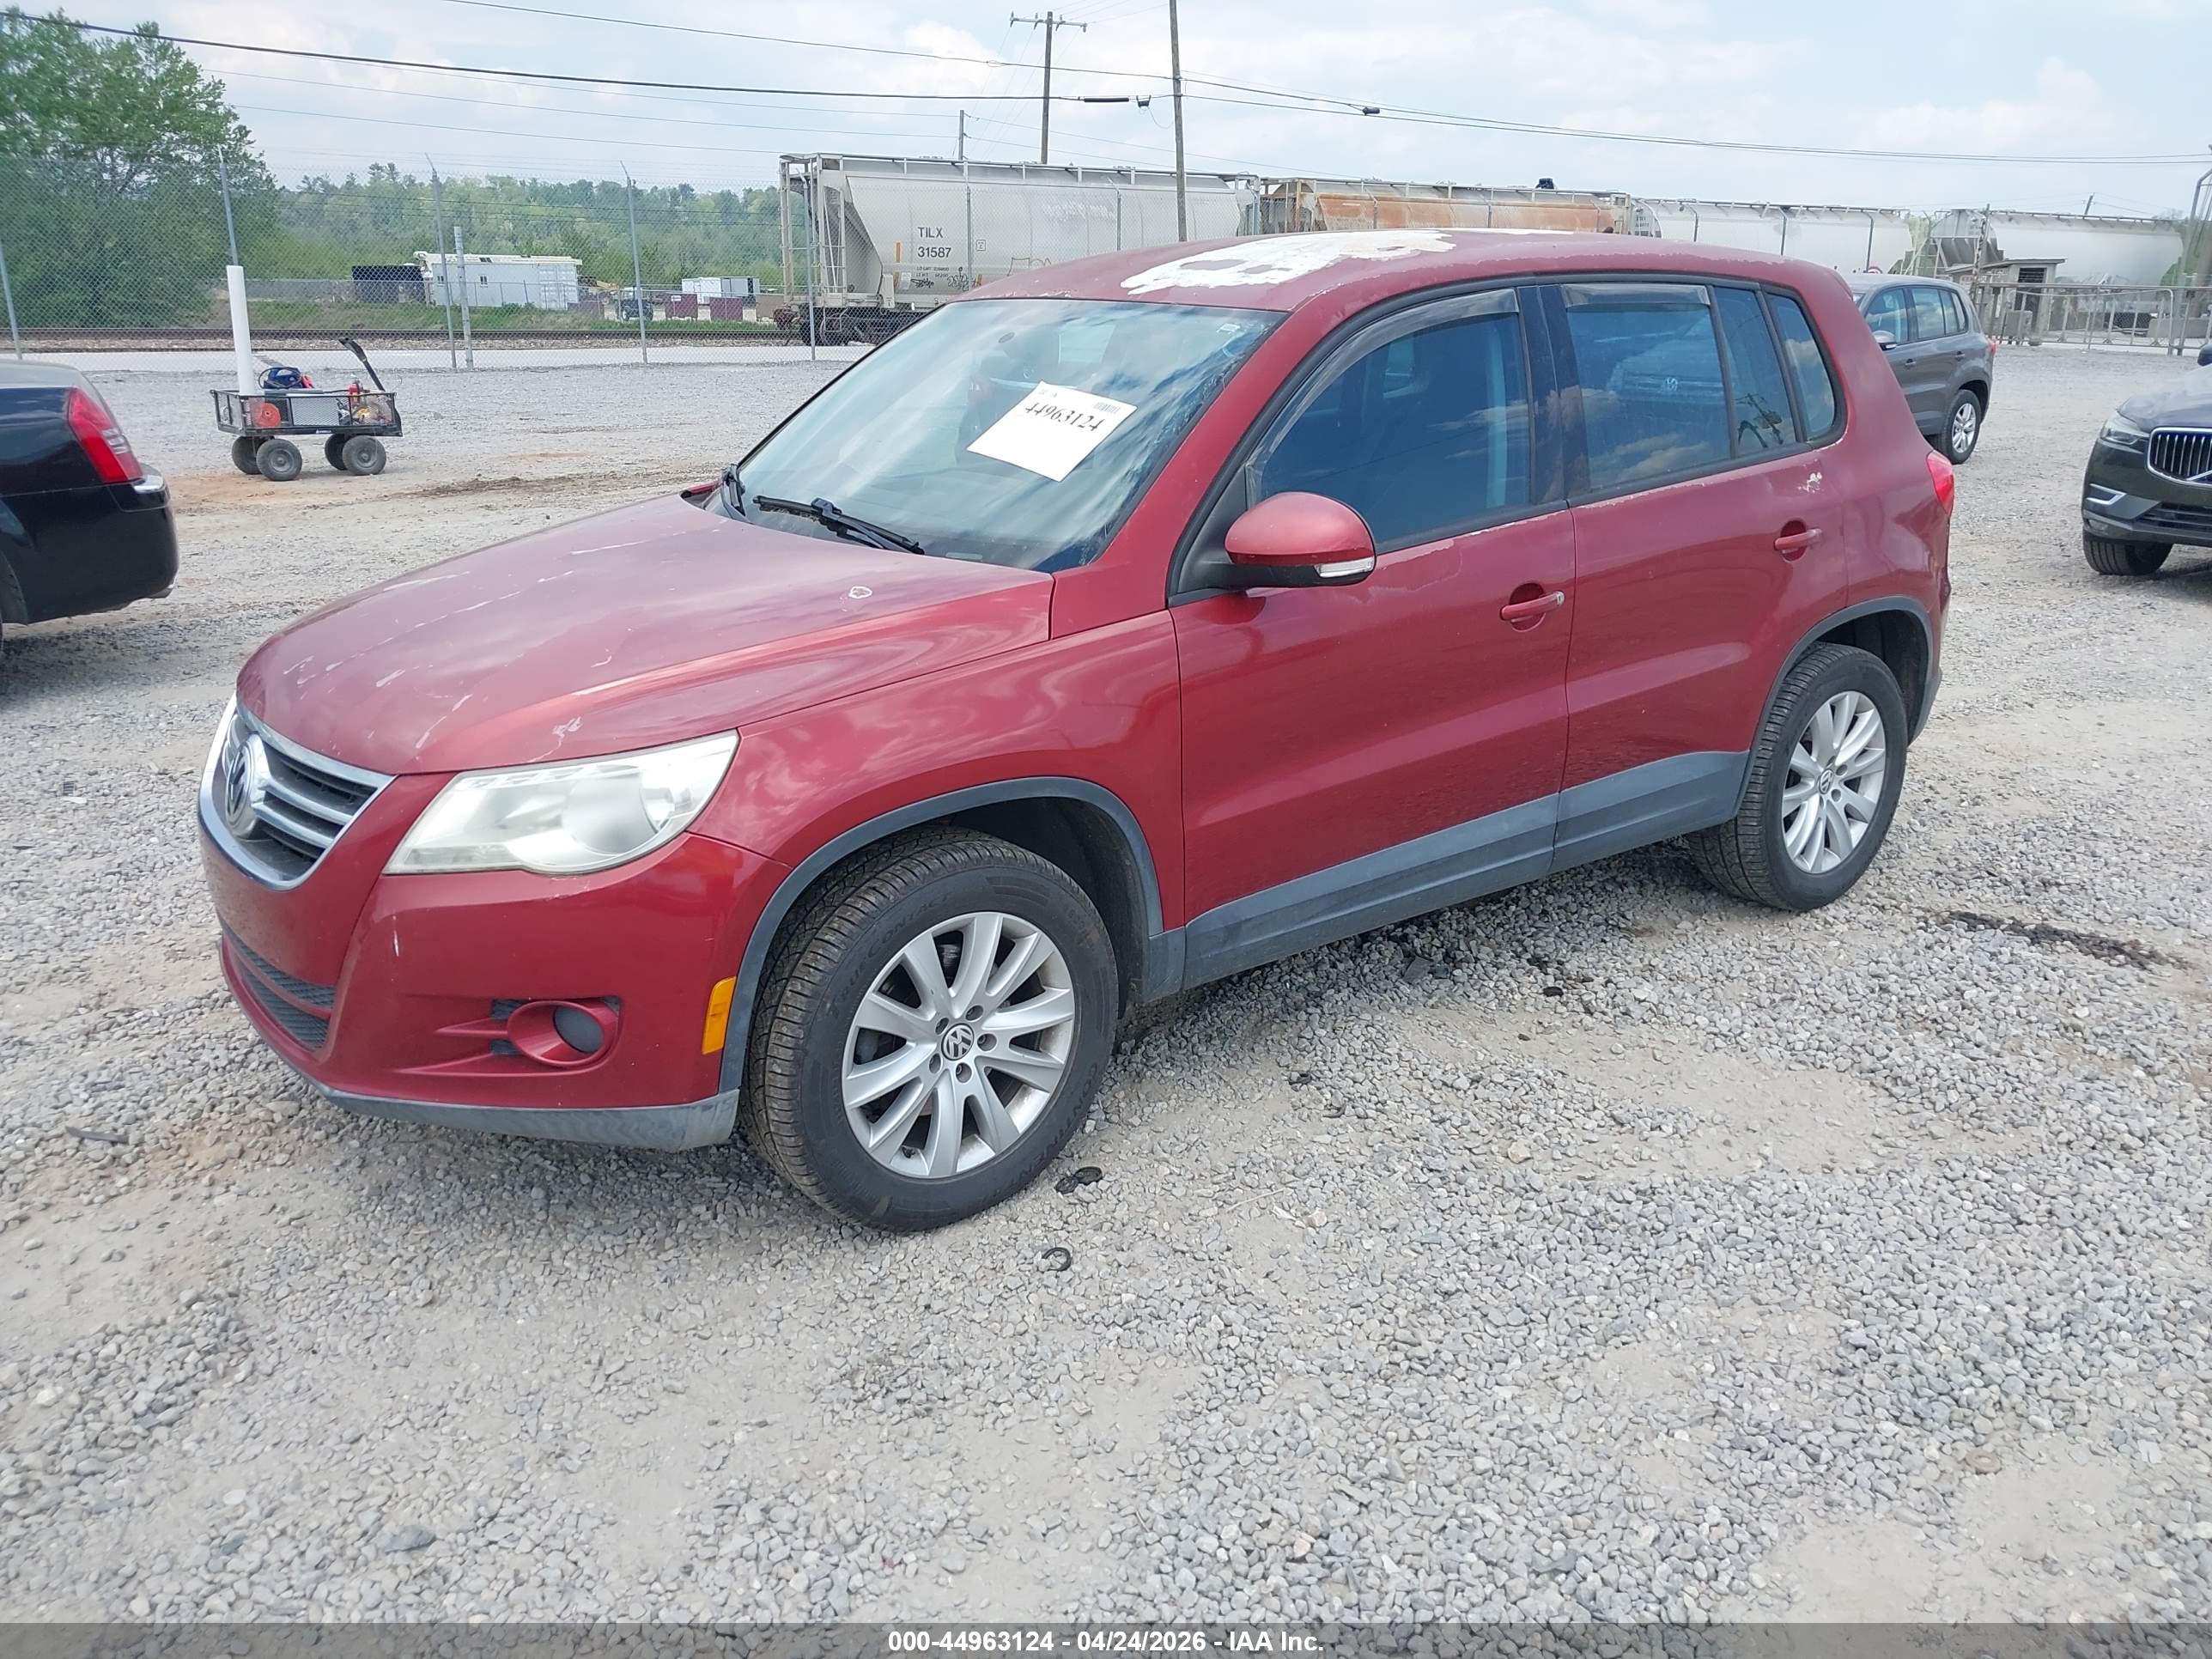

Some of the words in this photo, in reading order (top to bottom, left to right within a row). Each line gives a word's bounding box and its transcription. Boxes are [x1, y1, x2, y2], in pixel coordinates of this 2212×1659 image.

[918, 227, 943, 238] TILX
[918, 246, 951, 258] 31587
[1025, 403, 1105, 431] 44963124
